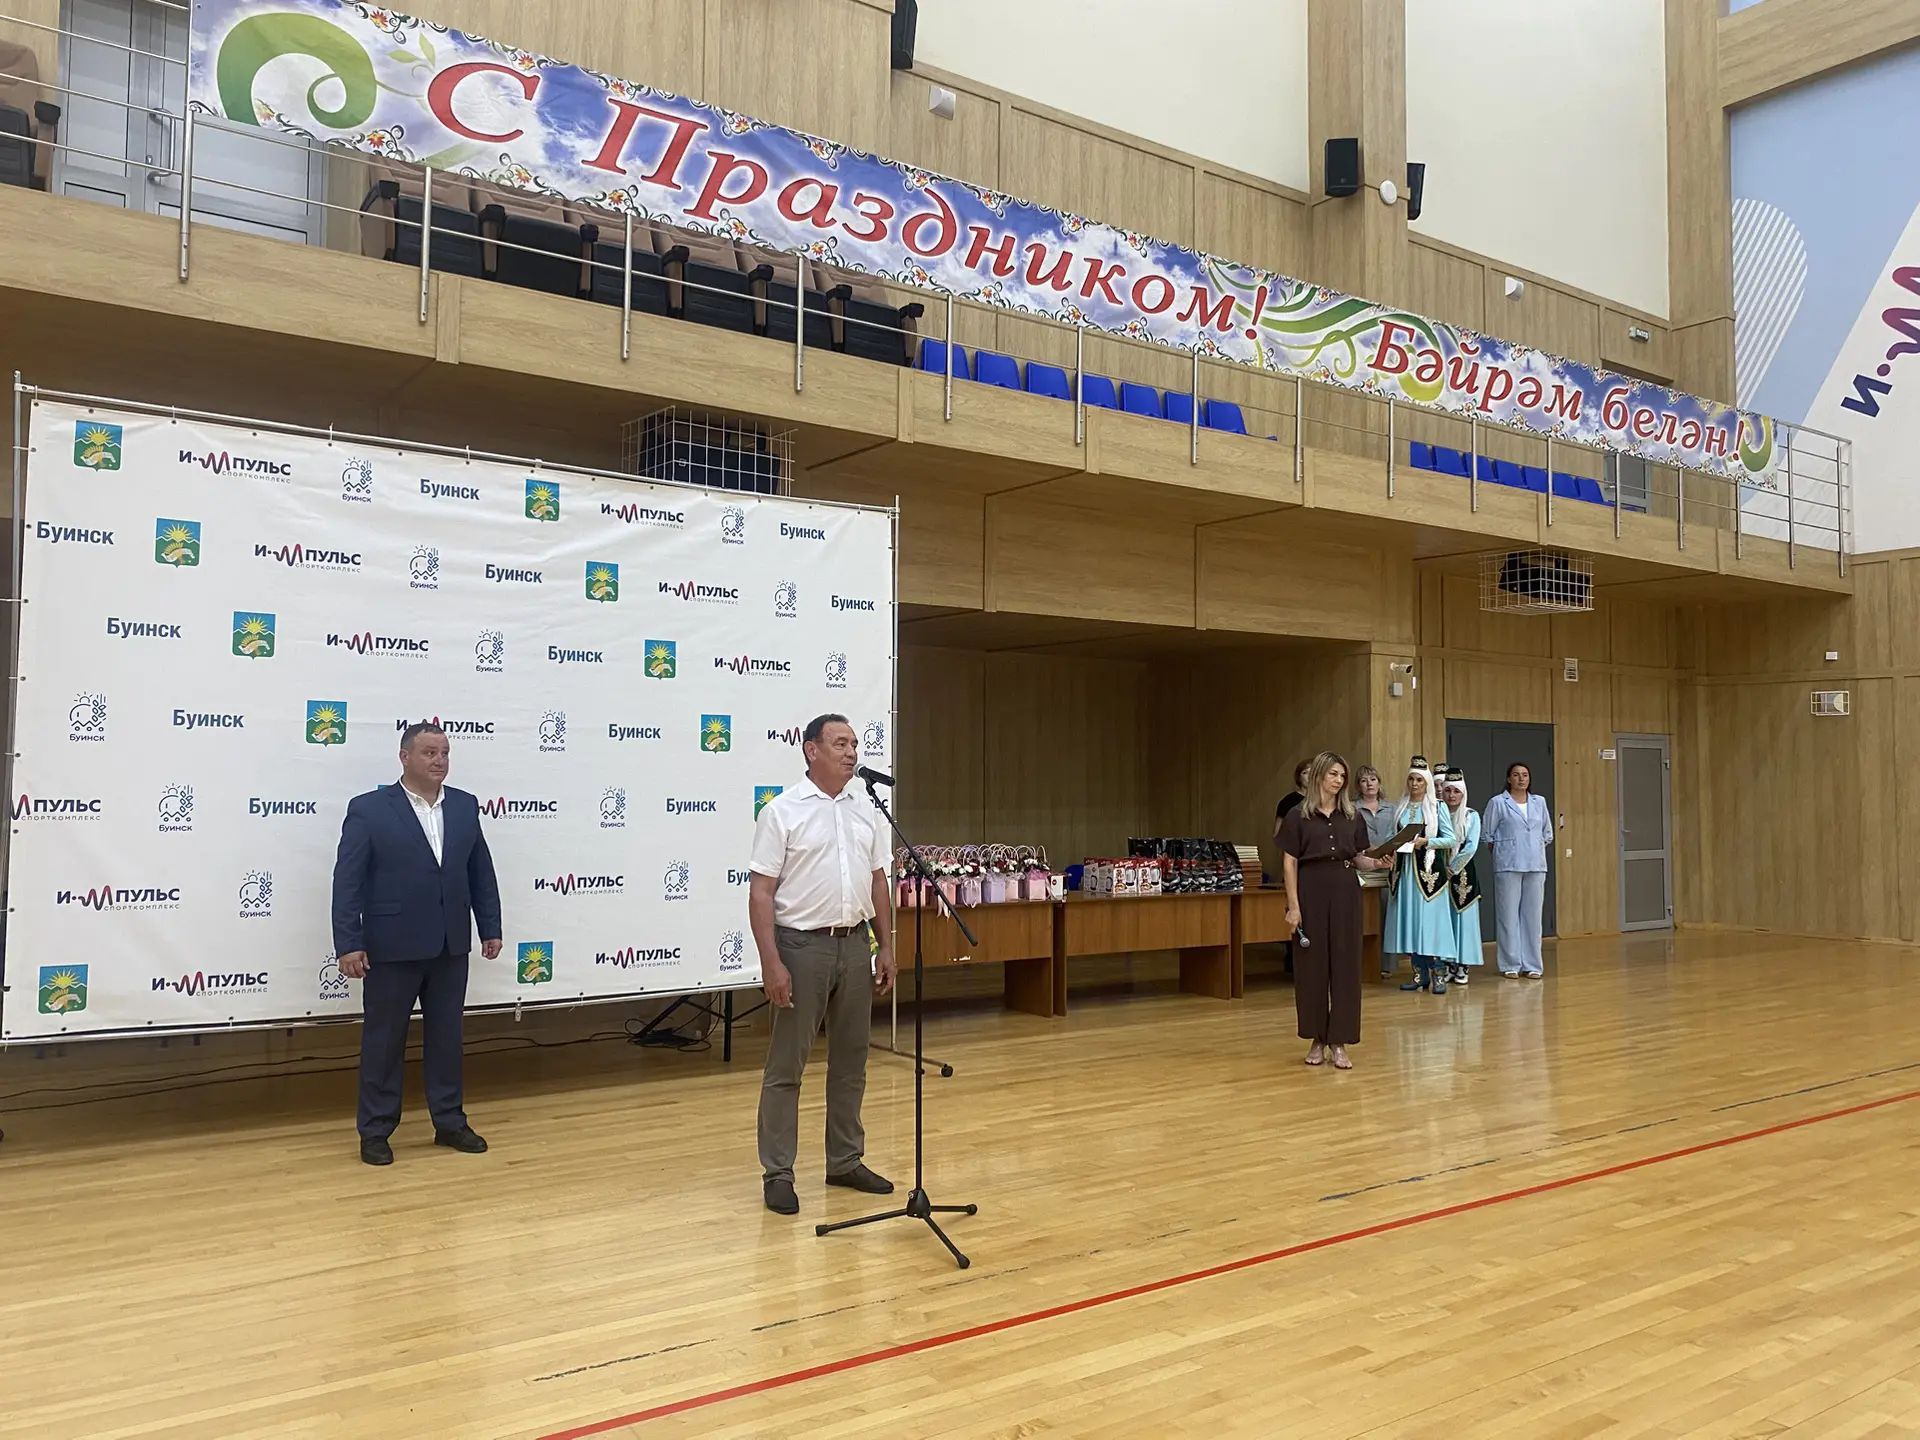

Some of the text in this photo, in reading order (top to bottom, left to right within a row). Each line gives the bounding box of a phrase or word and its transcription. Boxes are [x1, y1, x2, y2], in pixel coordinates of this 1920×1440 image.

[427, 62, 1268, 341] С Праздником!
[1366, 320, 1746, 462] Бәйрәм белән!
[222, 470, 291, 484] СПОРТКОМПЛЕКС
[342, 492, 372, 503] Буинск
[421, 479, 479, 500] Буинск
[37, 521, 113, 545] Буинск
[781, 523, 825, 540] Буинск
[295, 562, 361, 573] СПОРТКОМПЛЕКС
[486, 564, 542, 583] Буинск
[410, 580, 439, 591] Буинск
[832, 595, 874, 611] Буинск
[107, 617, 181, 638] Буинск
[366, 650, 428, 659] СПОРТКОМПЛЕКС
[548, 646, 603, 664] Буинск
[173, 710, 244, 730] Буинск
[69, 734, 104, 743] Буинск
[609, 724, 661, 741] Буинск
[249, 798, 316, 817] Буинск
[667, 798, 716, 815] Буинск
[159, 824, 193, 833] Буинск
[728, 869, 751, 886] Буи
[104, 904, 180, 912] СПОРТКОМПЛЕКС
[196, 988, 268, 997] СПОРТКОМПЛЕКС
